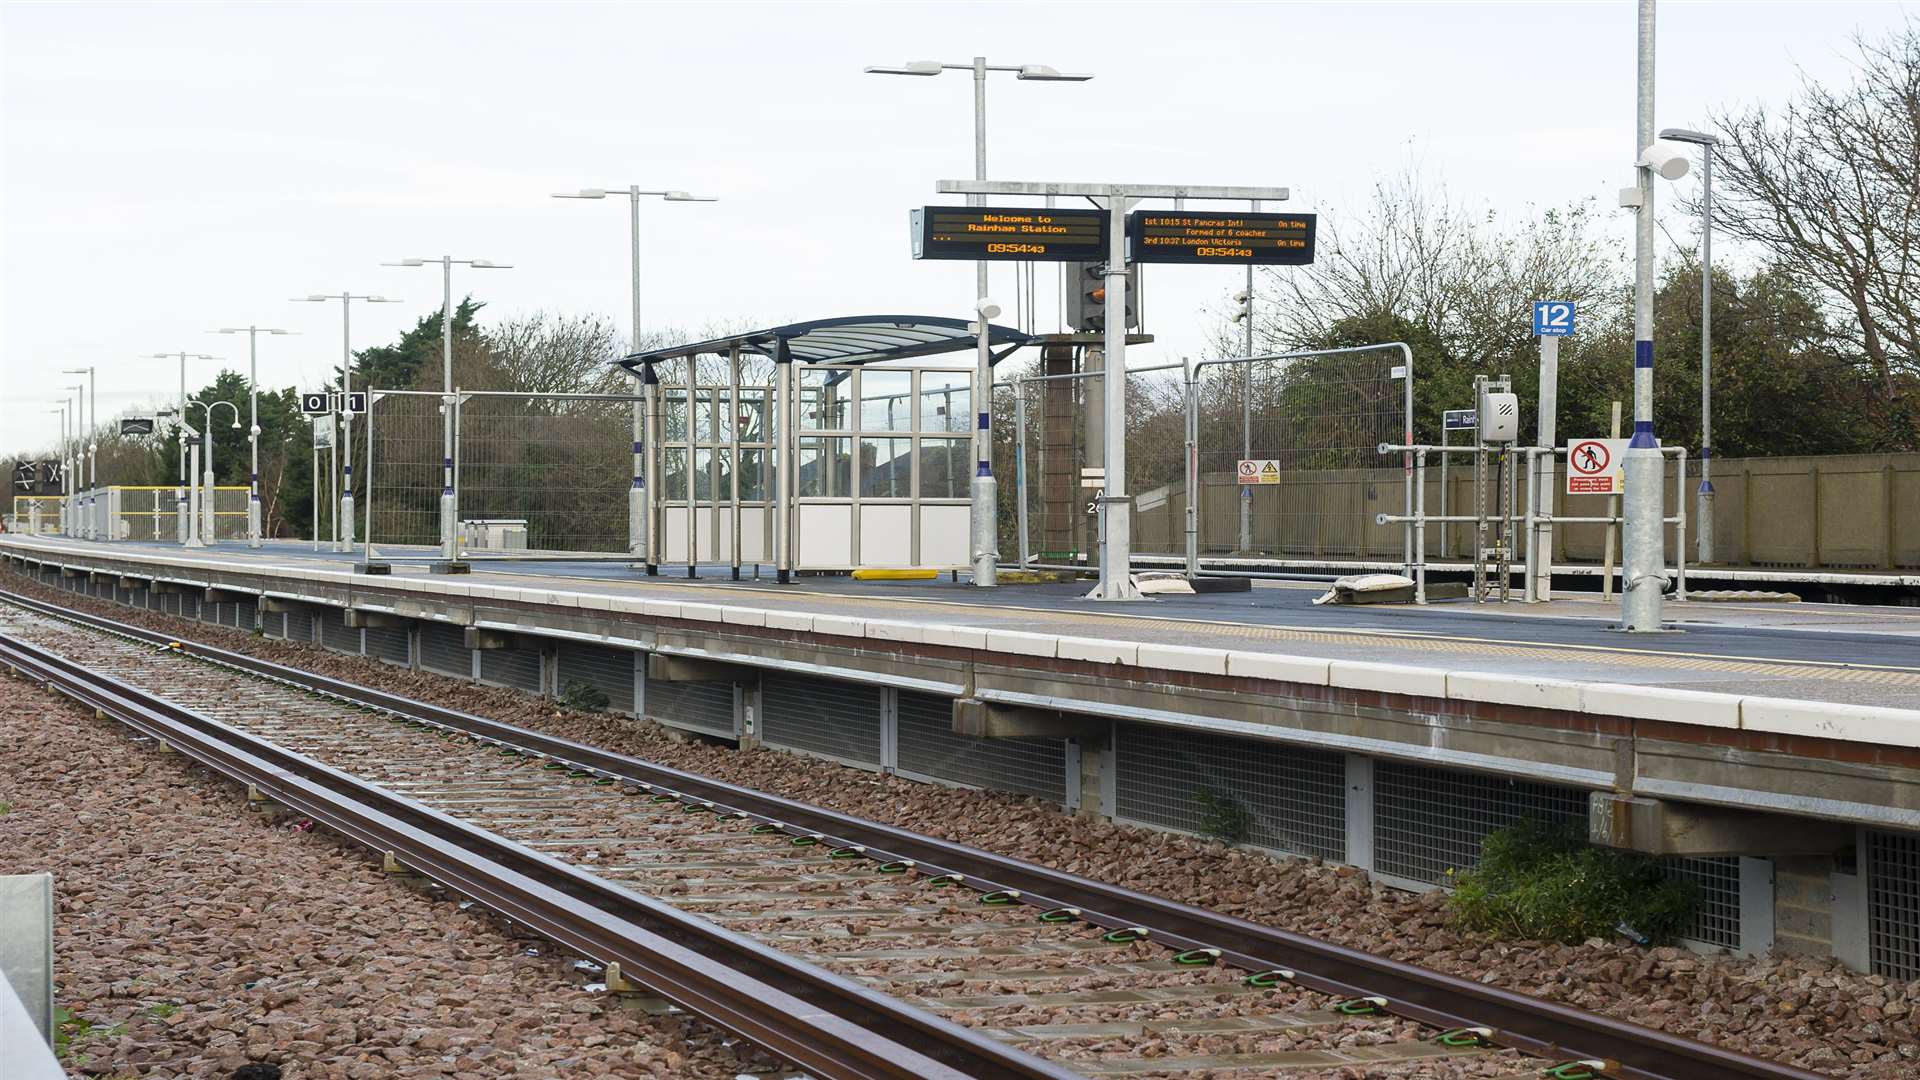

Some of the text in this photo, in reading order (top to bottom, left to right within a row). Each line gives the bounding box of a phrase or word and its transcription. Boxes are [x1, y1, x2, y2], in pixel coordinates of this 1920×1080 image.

[983, 215, 1032, 223] Welcome
[968, 224, 1067, 233] Rainham Station
[1194, 219, 1225, 227] Pancras
[1278, 220, 1287, 228] On
[1291, 221, 1306, 229] time
[1211, 238, 1241, 246] Victoria
[987, 244, 1045, 254] 09:54:43
[1197, 247, 1252, 256] 09:54:43
[1538, 304, 1569, 326] 12
[348, 396, 356, 409] 1
